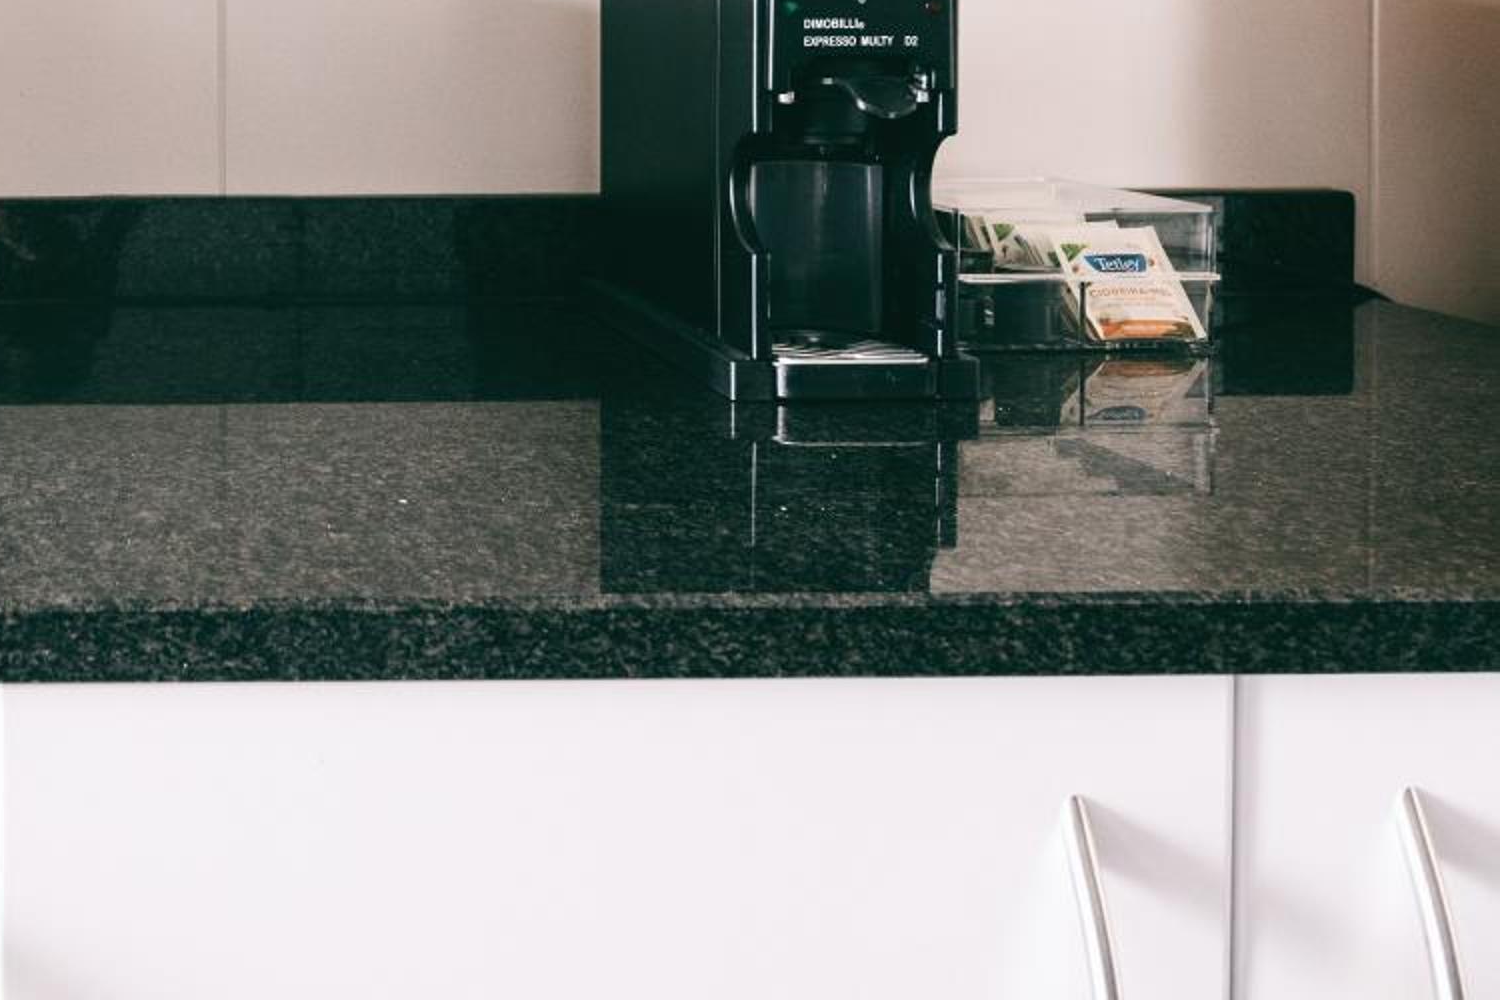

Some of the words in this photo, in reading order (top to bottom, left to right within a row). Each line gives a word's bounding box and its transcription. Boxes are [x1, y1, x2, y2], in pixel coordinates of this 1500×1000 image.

[803, 35, 857, 47] EXPRESSO
[860, 35, 894, 47] MULTY
[903, 35, 919, 47] D2
[1093, 256, 1140, 272] Tetley
